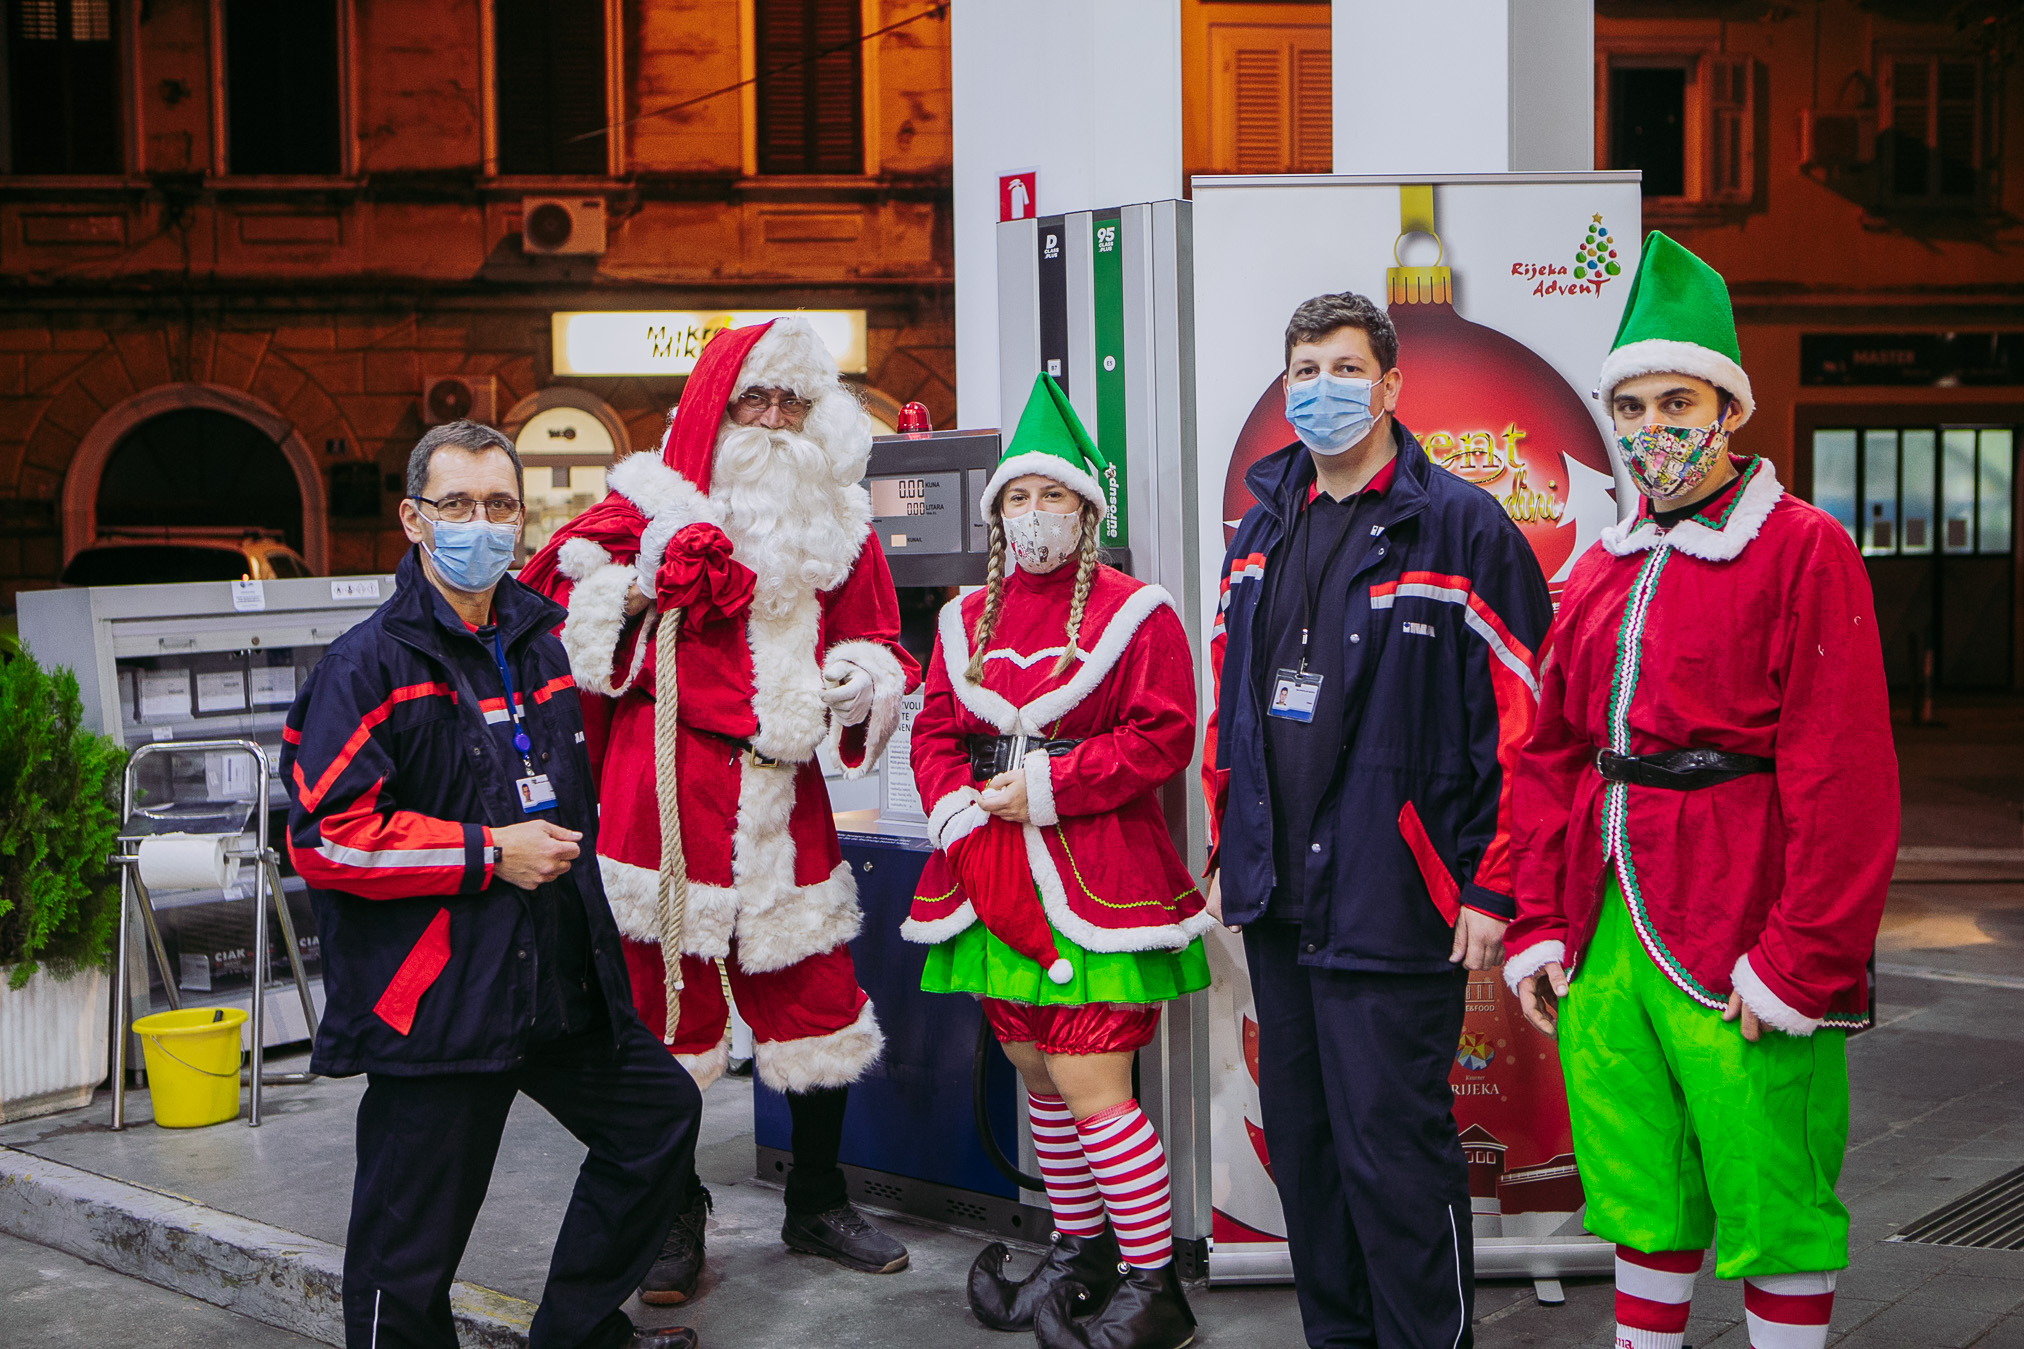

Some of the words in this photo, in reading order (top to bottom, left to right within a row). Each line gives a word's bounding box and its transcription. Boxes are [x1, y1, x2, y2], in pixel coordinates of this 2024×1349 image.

[1046, 234, 1057, 249] D
[1097, 227, 1115, 242] 95
[1511, 262, 1568, 281] Rijeka
[1413, 422, 1526, 469] ent
[899, 480, 924, 498] 0.00
[899, 724, 911, 732] EN
[215, 949, 245, 962] CIAK
[1465, 1004, 1495, 1012] E&FOOD
[1451, 1083, 1500, 1096] RIJEKA
